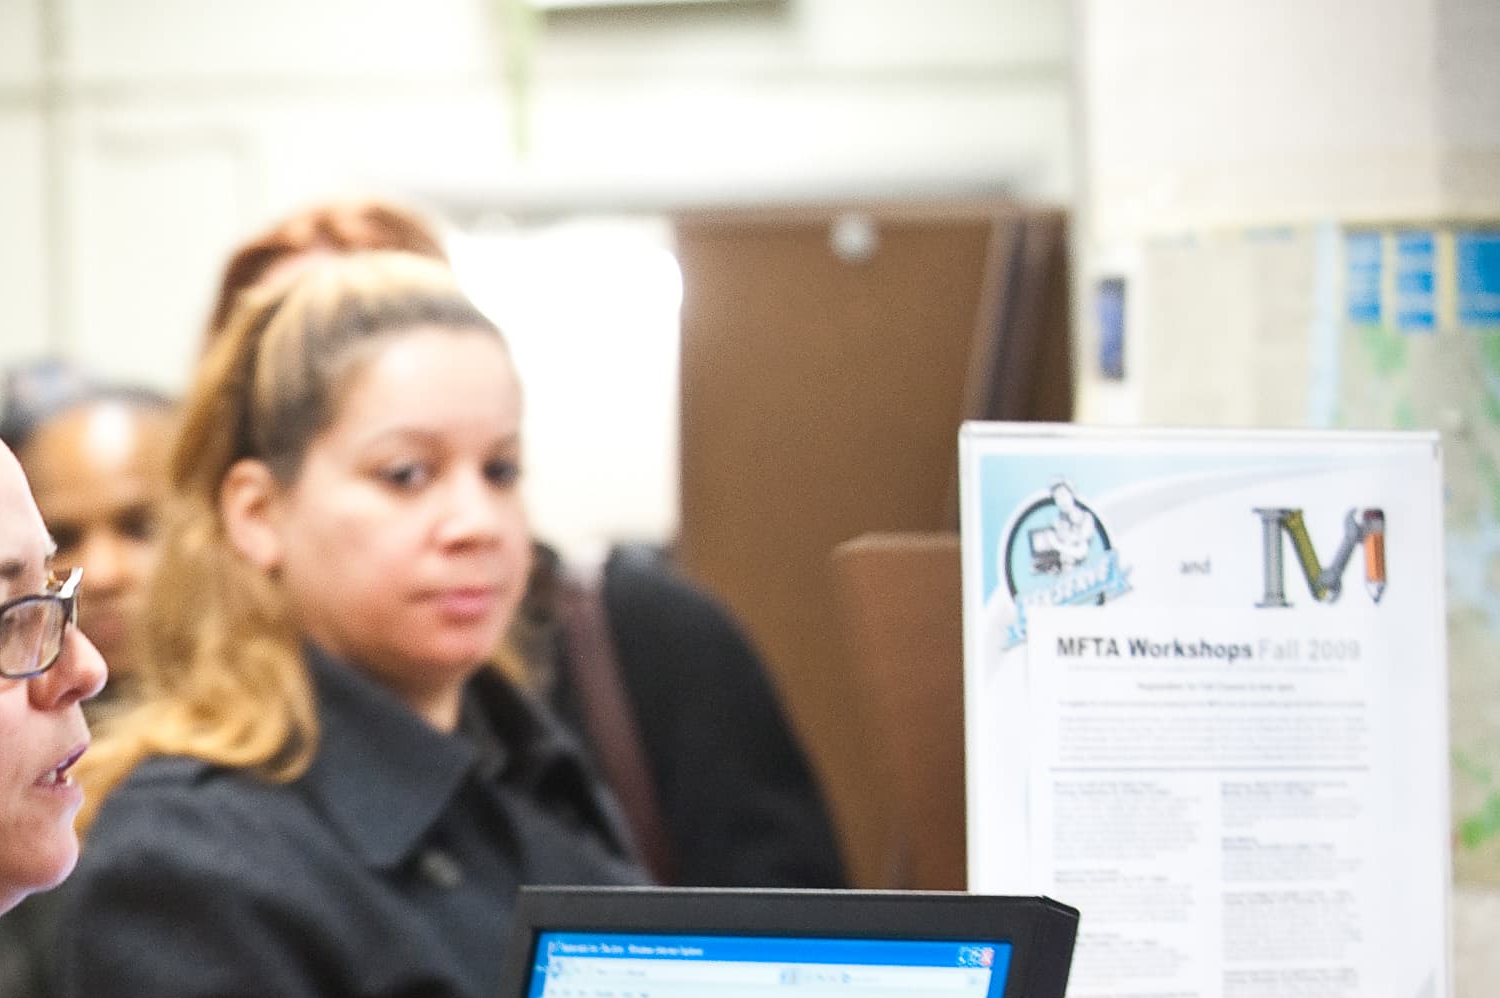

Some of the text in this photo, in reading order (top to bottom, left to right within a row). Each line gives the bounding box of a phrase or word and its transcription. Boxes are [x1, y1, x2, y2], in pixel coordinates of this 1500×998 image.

[1180, 554, 1212, 575] and
[1056, 636, 1362, 664] MFTA Workshops Fall 2009
